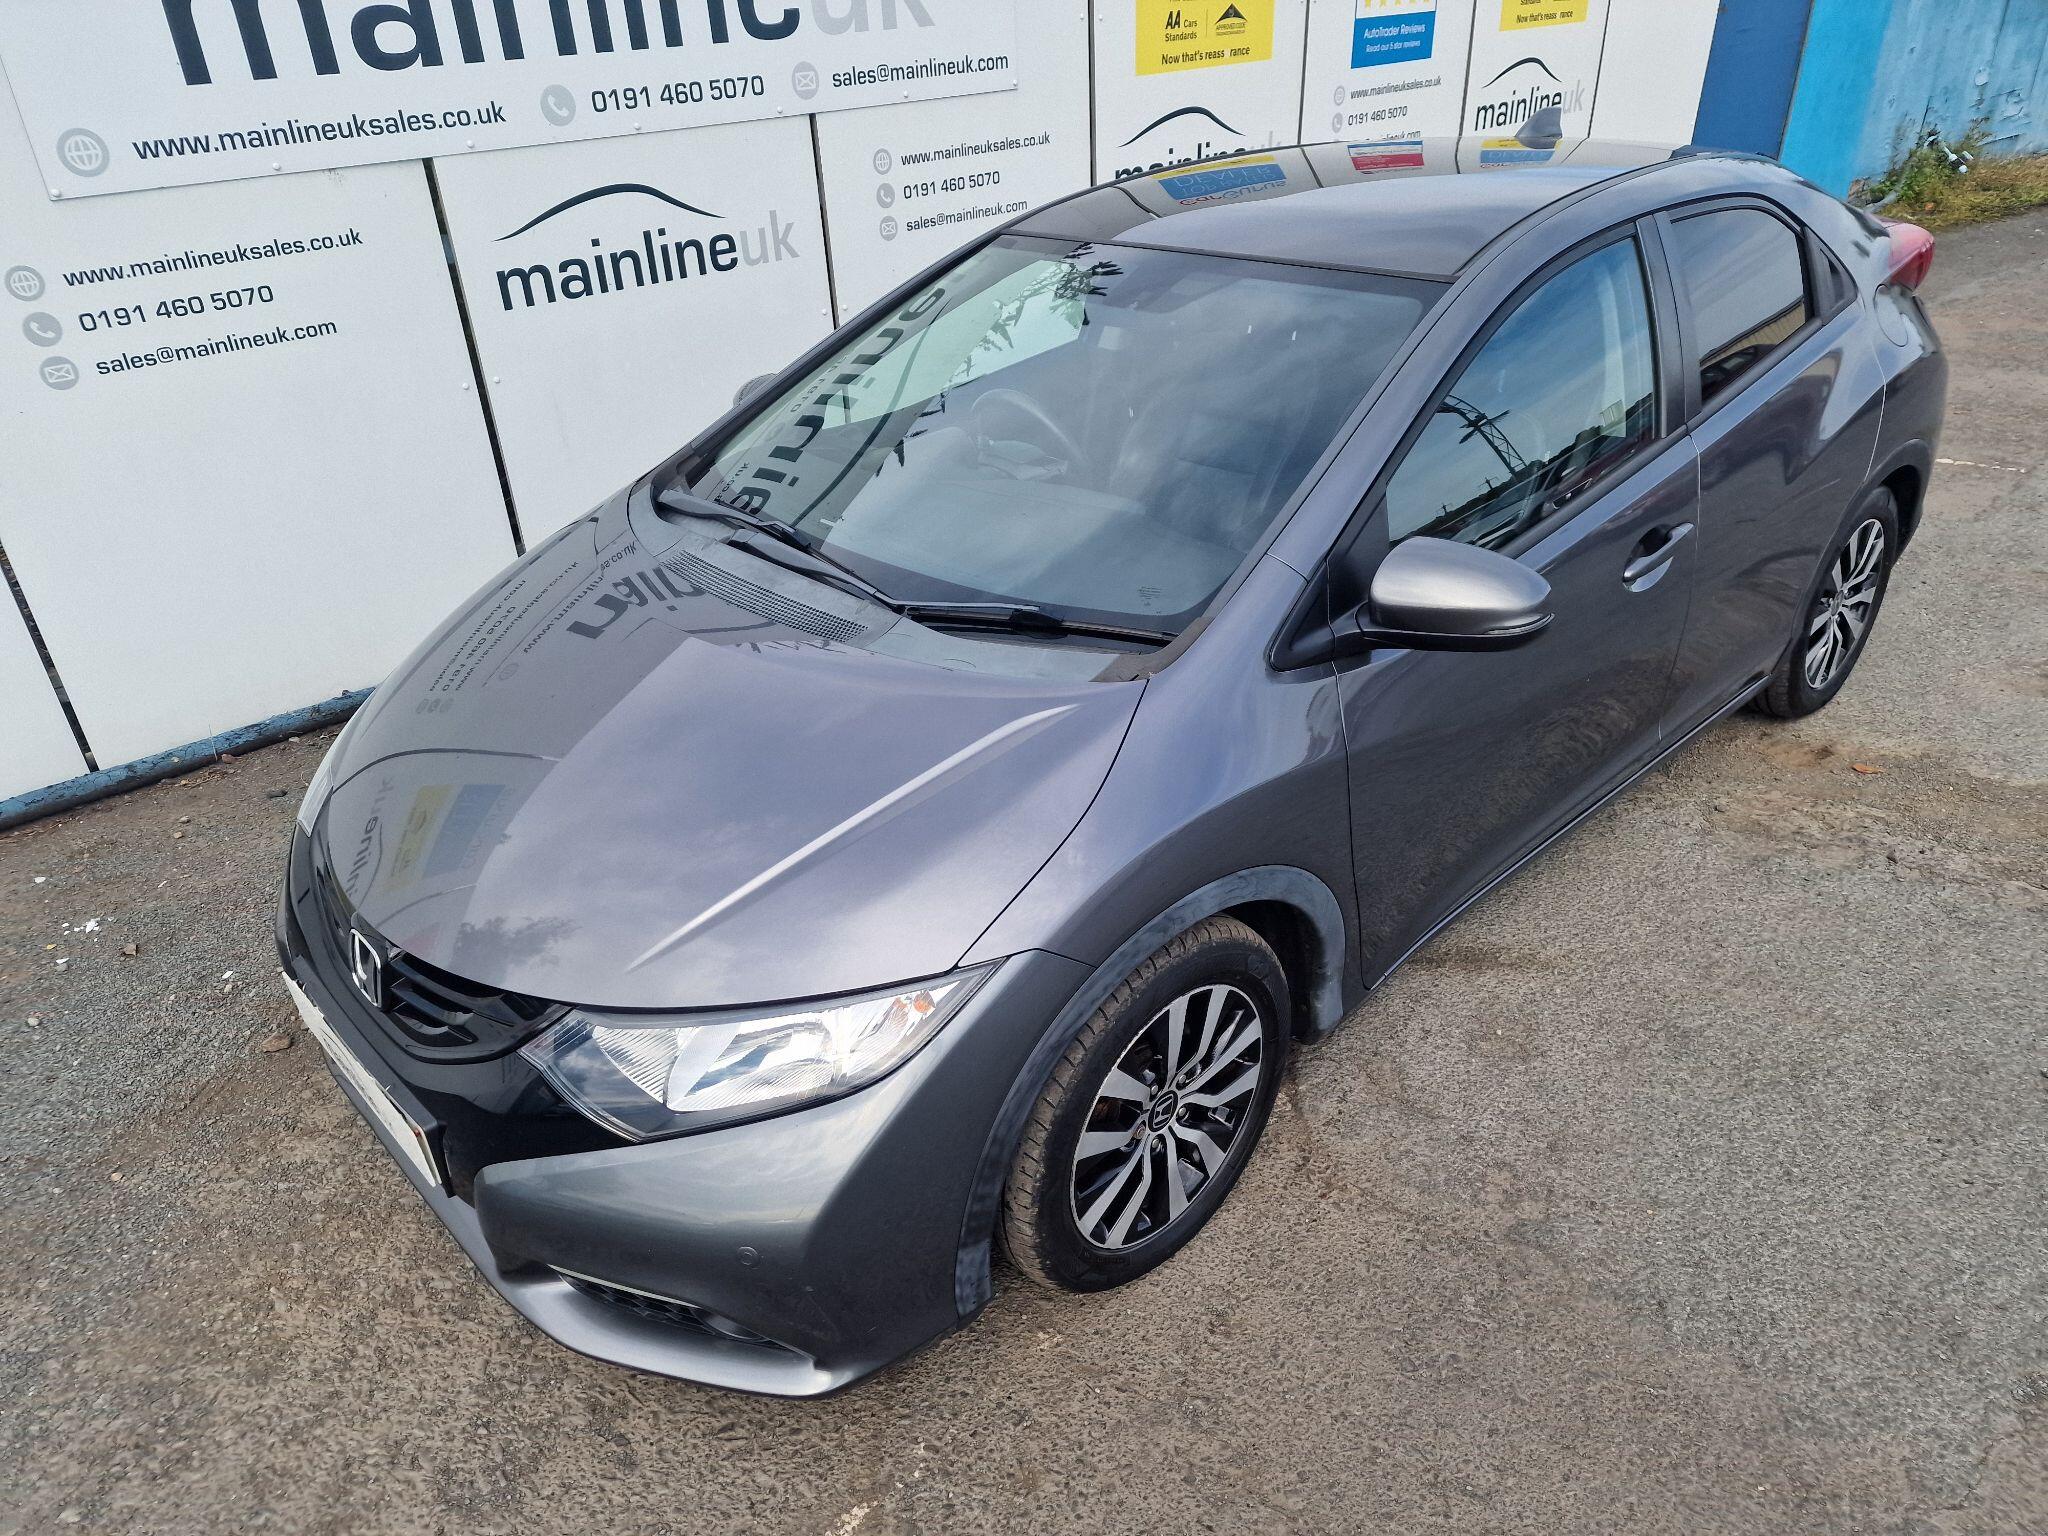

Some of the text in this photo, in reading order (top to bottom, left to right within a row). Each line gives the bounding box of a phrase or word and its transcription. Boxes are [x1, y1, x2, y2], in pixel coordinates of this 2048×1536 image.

[1165, 9, 1198, 30] AA Cars
[1399, 23, 1426, 35] Reviews
[1165, 31, 1198, 42] Standards
[1161, 52, 1181, 65] Now
[1182, 49, 1204, 63] that's
[132, 53, 1009, 160] www.mainlineuksales.co.uk 0191 460 5070 sales@mainlineuk.com
[1347, 105, 1408, 126] 0191 460 5070
[900, 130, 1051, 166] www.mainlineuksales.co.uk
[903, 171, 1000, 199] 0191 460 5070
[906, 200, 1028, 231] sales@mainlineuk.com
[62, 228, 364, 287] www.mainlineuksales.co.uk
[78, 284, 274, 333] 0191 460 5070
[95, 318, 338, 376] sales@mainlineuk.com
